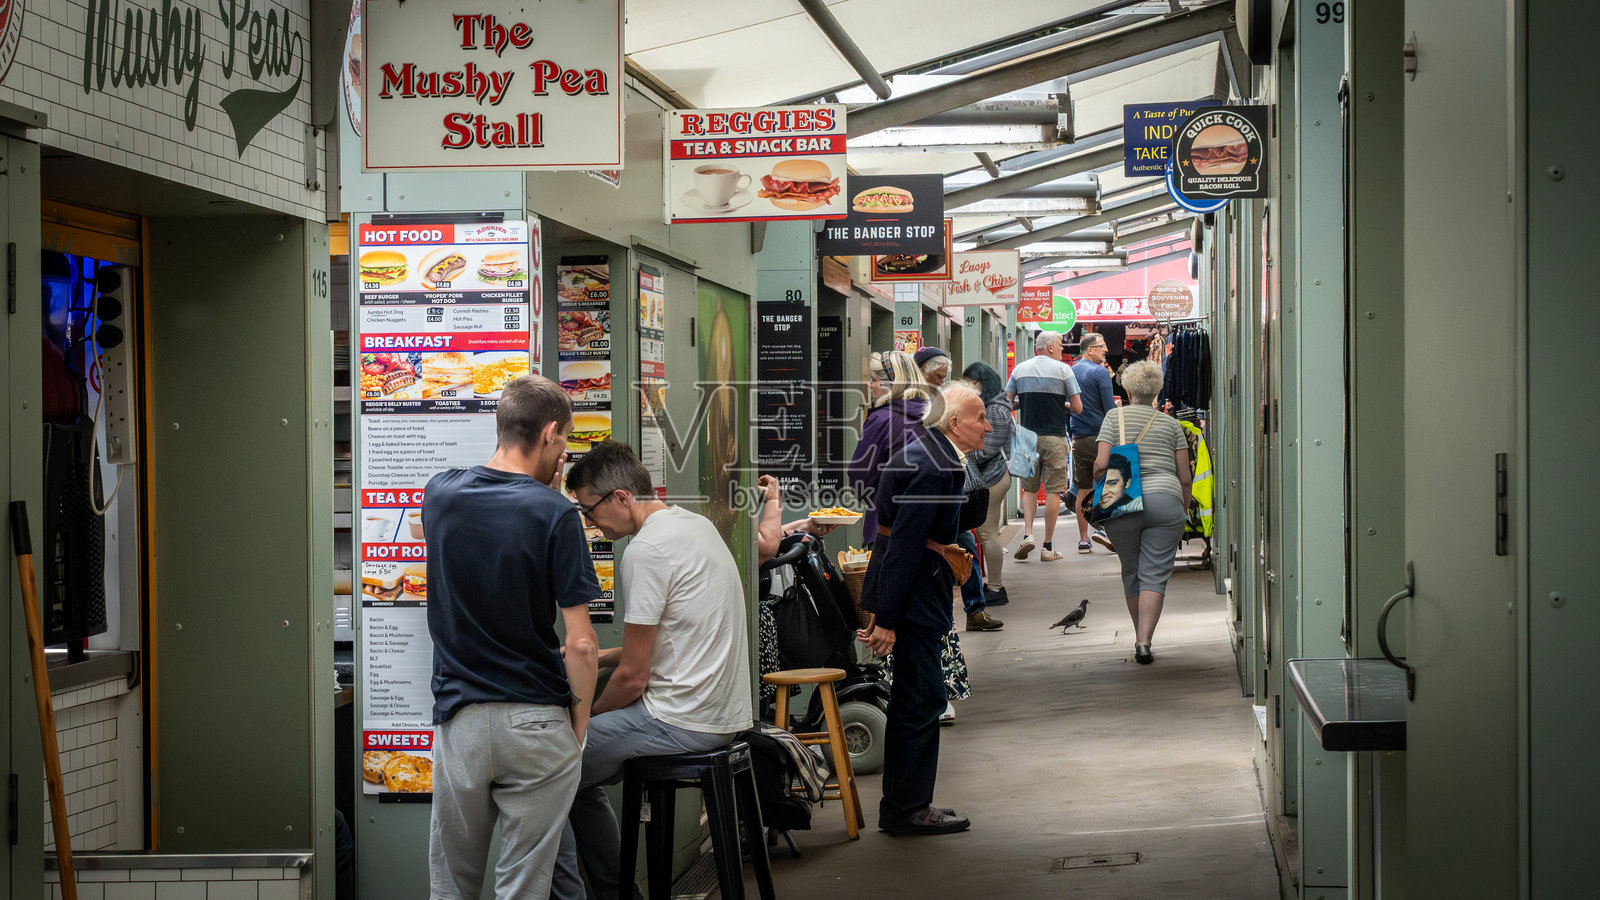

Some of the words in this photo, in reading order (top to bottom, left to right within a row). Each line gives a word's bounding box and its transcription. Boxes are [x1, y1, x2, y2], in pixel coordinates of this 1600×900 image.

[1316, 2, 1344, 24] 99
[453, 13, 534, 57] The
[83, 0, 206, 132] Mushy
[218, 0, 303, 81] Peas
[379, 61, 514, 105] Mushy
[529, 60, 609, 95] Pea
[1144, 110, 1165, 118] Taste
[1168, 108, 1176, 120] of
[680, 108, 836, 136] REGGIES
[1186, 114, 1224, 139] QUICK
[1226, 116, 1256, 142] COOK
[441, 112, 545, 149] Stall
[683, 142, 720, 156] TEA
[720, 141, 732, 154] &
[735, 139, 794, 156] SNACK
[796, 138, 832, 152] BAR
[1134, 146, 1168, 160] TAKE
[365, 231, 396, 243] HOT
[400, 230, 443, 242] FOOD
[476, 226, 507, 234] REGGIES
[828, 227, 849, 240] THE
[854, 226, 900, 239] BANGER
[906, 226, 936, 238] STOP
[959, 260, 991, 274] Lucys
[312, 268, 327, 298] 115
[948, 281, 972, 296] Fish
[982, 274, 1013, 288] Chips
[786, 290, 802, 301] 80
[901, 316, 913, 325] 60
[365, 336, 452, 348] BREAKFAST
[366, 492, 396, 504] TEA
[399, 492, 410, 504] &
[367, 546, 398, 558] HOT
[368, 734, 430, 746] SWEETS
